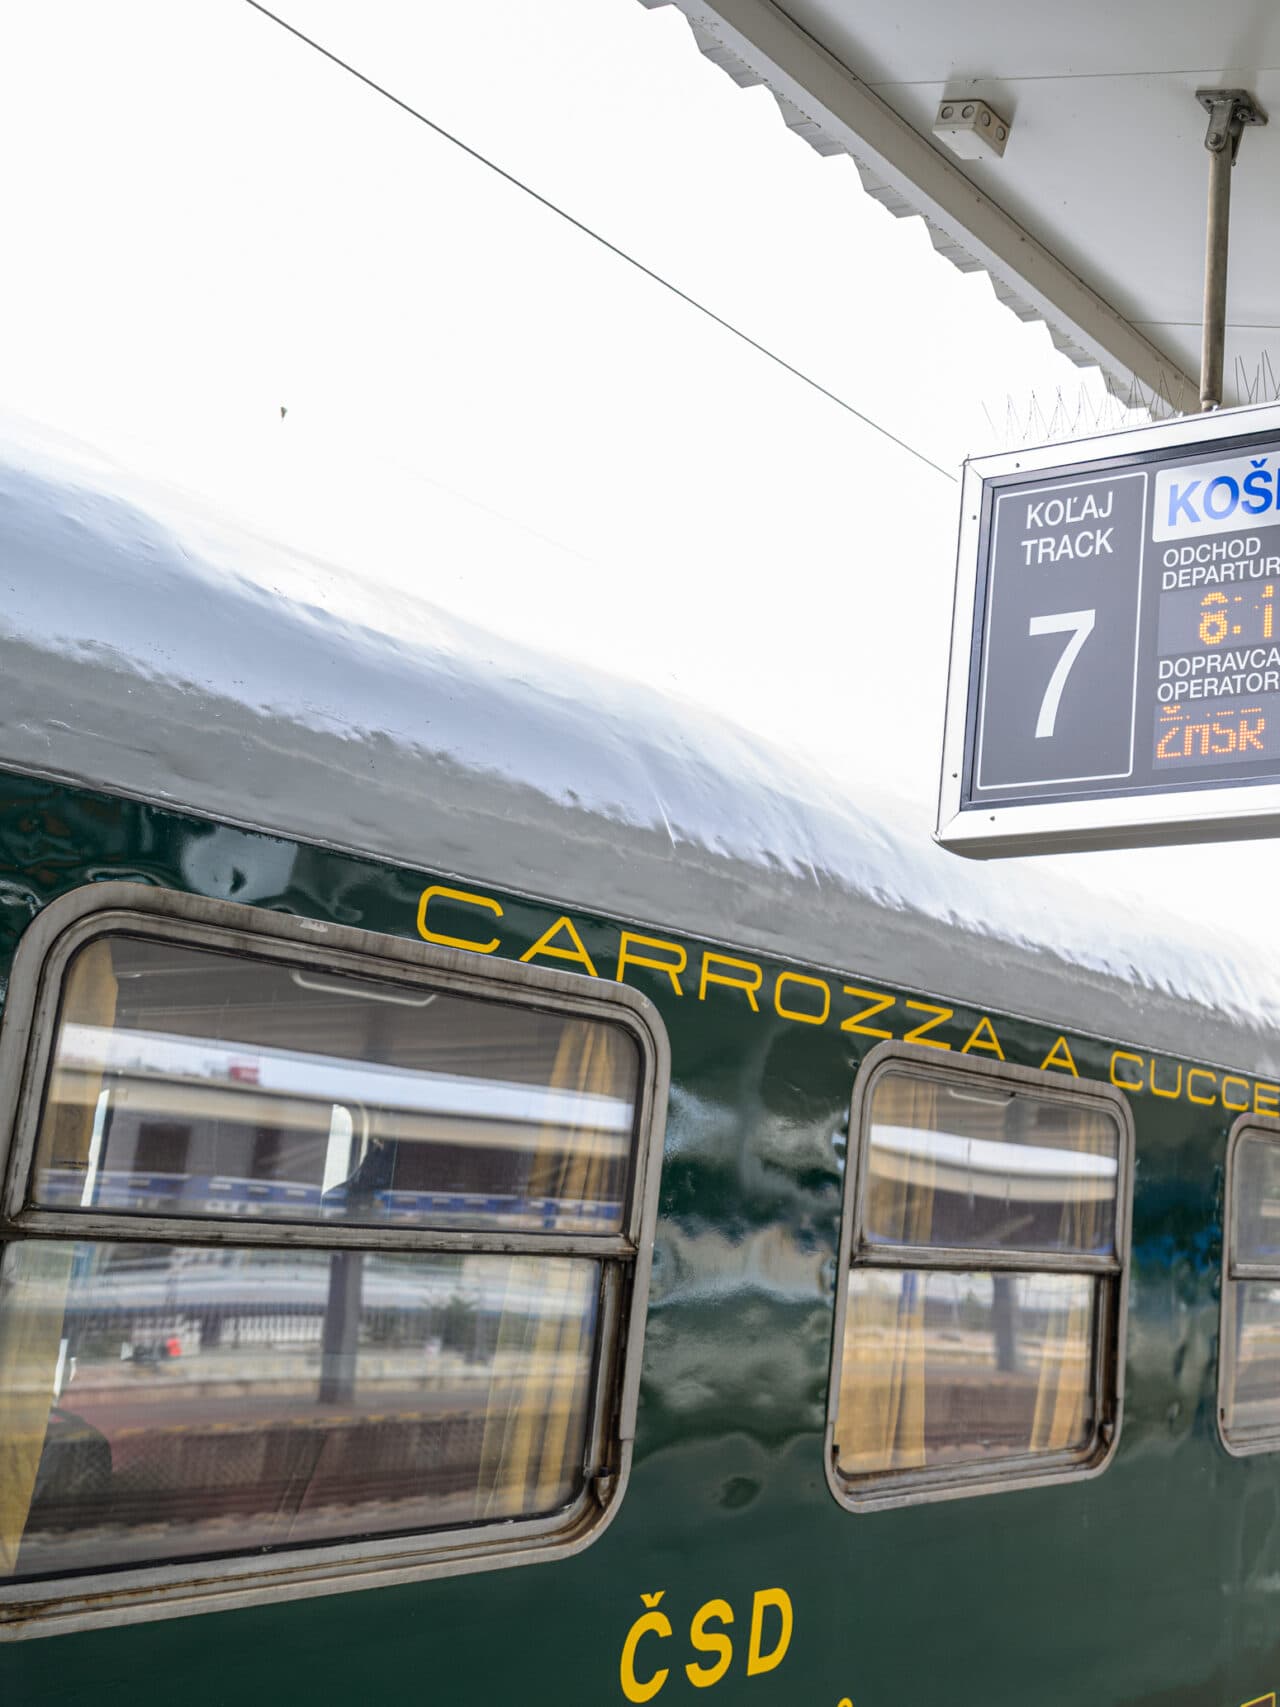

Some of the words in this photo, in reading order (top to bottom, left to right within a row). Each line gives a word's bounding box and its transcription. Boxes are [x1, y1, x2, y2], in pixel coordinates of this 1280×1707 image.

[1025, 491, 1114, 530] KOĽAJ
[1021, 527, 1114, 566] TRACK
[1162, 537, 1262, 568] ODCHOD
[1028, 608, 1096, 738] 7
[1157, 671, 1280, 702] OPERATOR
[416, 885, 1005, 1061] CARROZZA
[1040, 1036, 1079, 1078] A
[620, 1587, 793, 1703] ČSD
